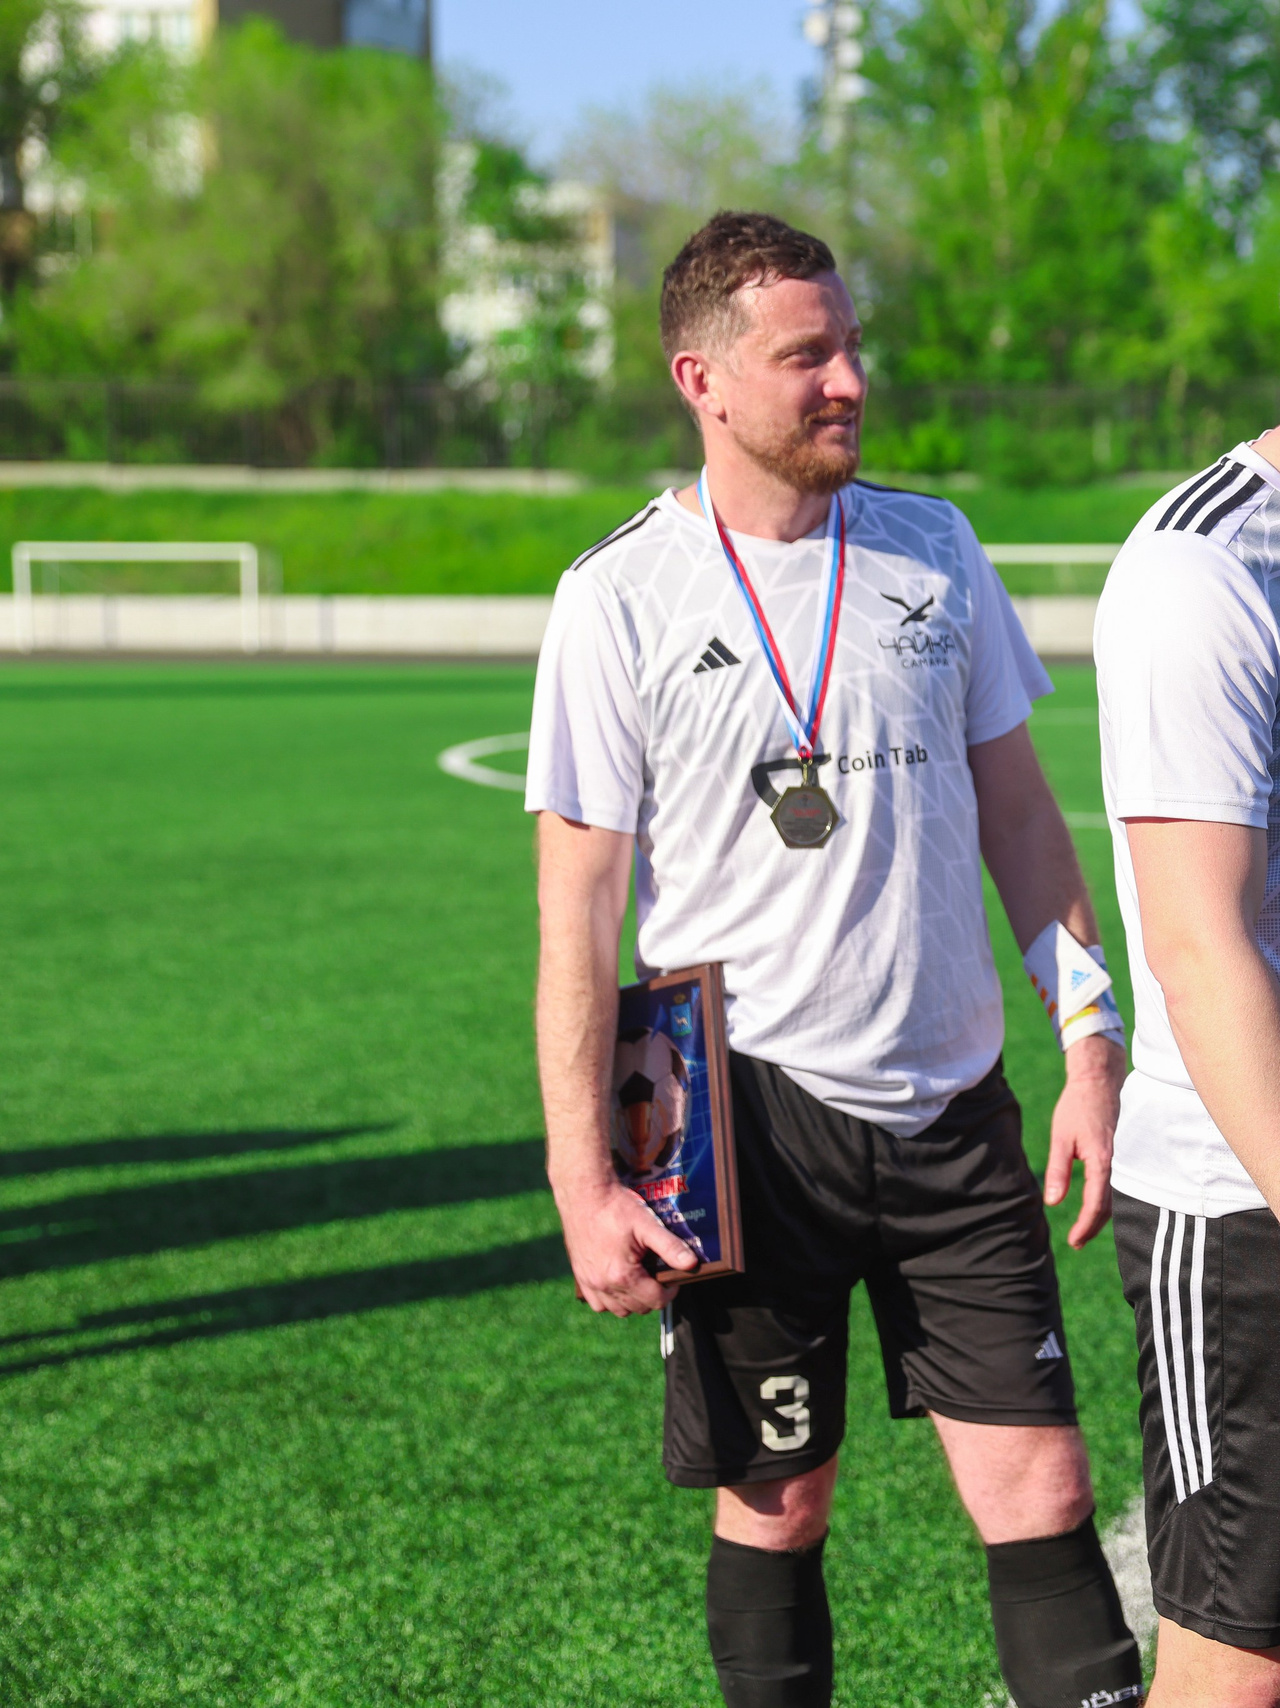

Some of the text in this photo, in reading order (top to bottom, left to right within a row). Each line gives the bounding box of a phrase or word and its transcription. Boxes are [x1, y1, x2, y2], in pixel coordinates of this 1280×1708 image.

[878, 631, 957, 655] ЧАЙКА
[901, 658, 949, 669] САМАРА
[838, 744, 928, 774] Coin Tab
[760, 1375, 810, 1452] 3
